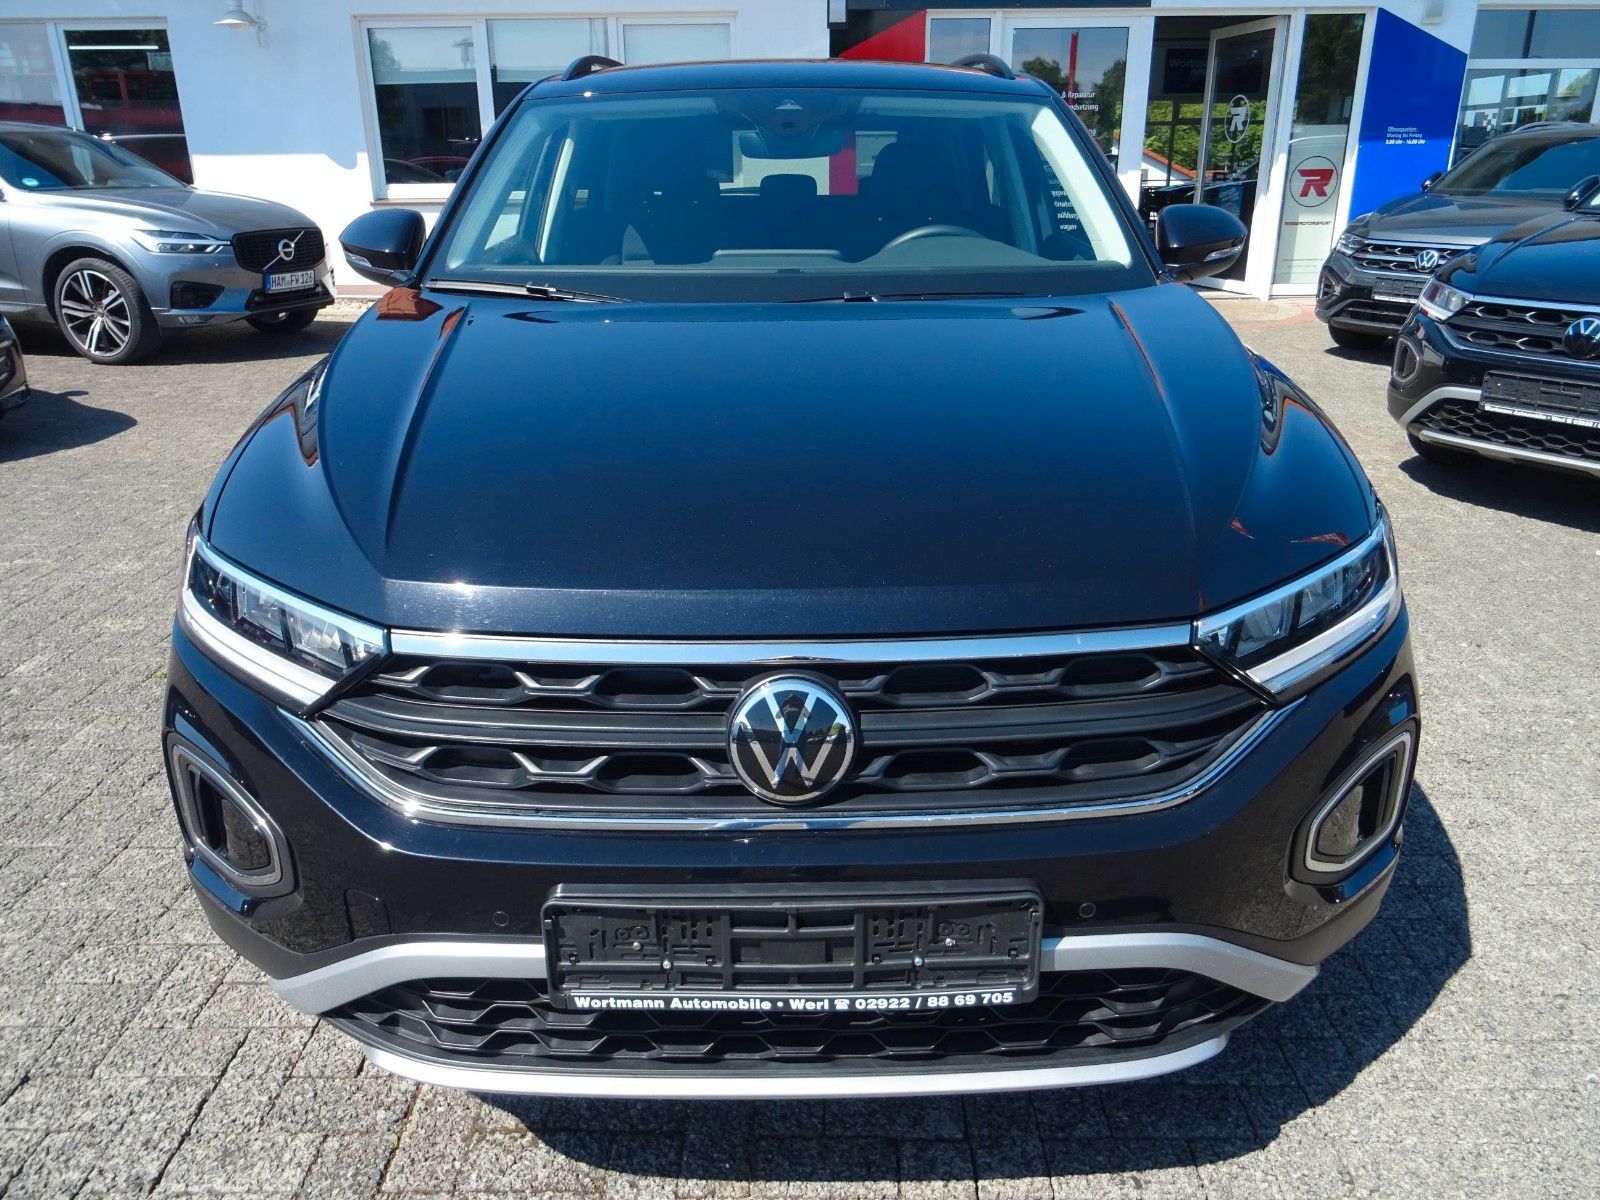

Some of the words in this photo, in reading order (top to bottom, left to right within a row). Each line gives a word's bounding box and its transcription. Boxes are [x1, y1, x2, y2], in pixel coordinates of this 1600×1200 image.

[1067, 91, 1096, 100] Reparatur
[271, 276, 287, 288] HAM
[574, 996, 665, 1009] Wortmann
[670, 997, 772, 1010] Automobile
[789, 998, 829, 1010] Werl
[855, 998, 910, 1010] 02922
[927, 995, 949, 1008] 88
[954, 993, 976, 1006] 69
[981, 992, 1013, 1005] 705
